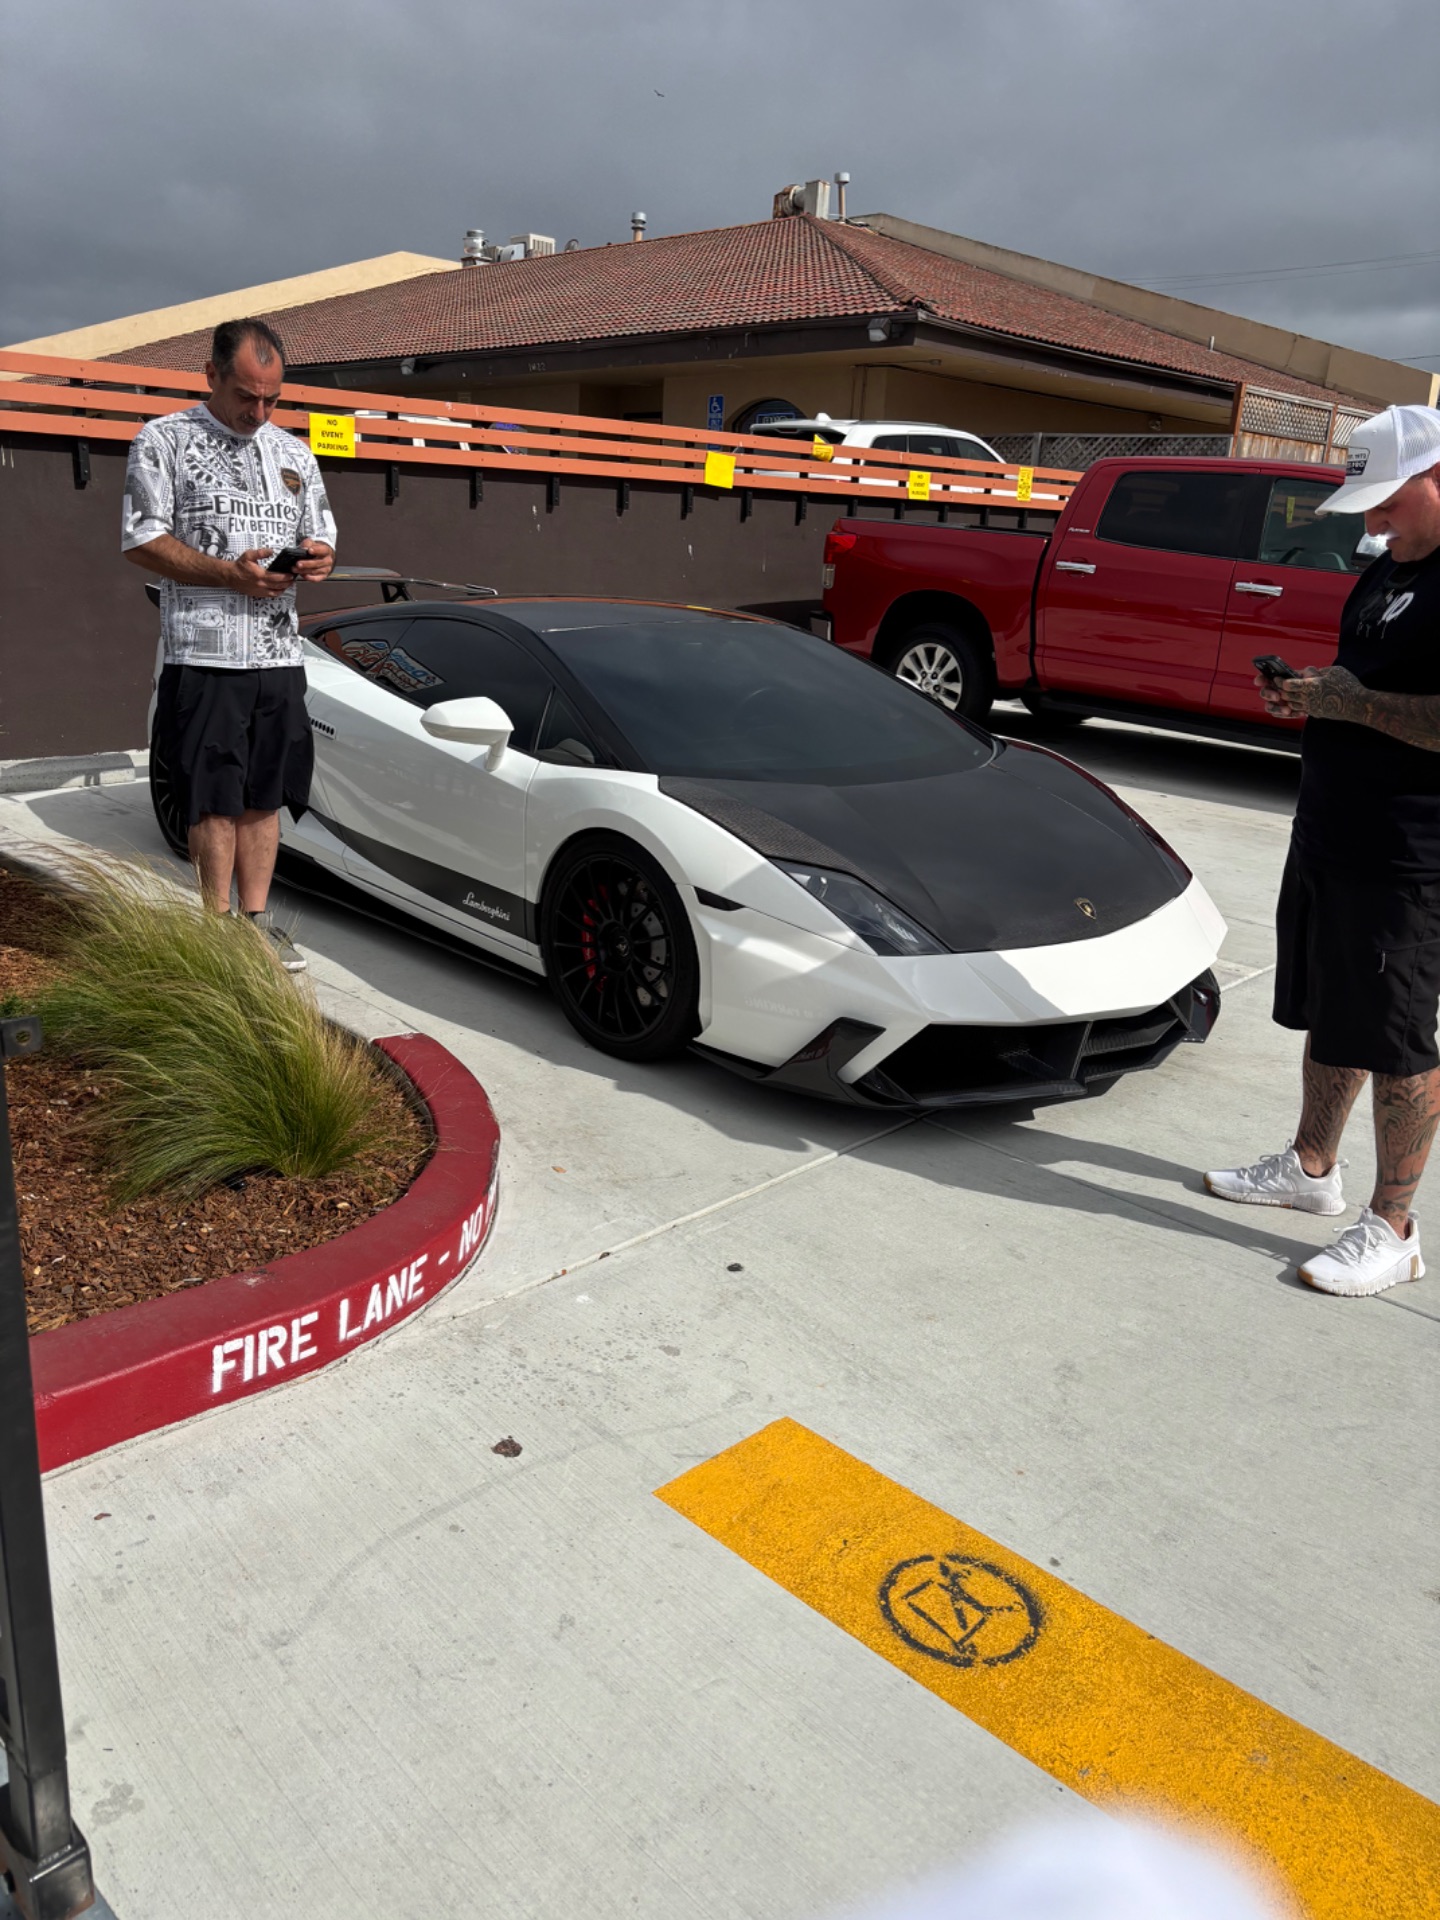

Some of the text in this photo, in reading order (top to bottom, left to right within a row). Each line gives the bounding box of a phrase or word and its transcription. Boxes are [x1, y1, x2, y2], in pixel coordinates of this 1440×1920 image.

[320, 430, 344, 439] EVENT
[316, 442, 349, 451] PARKING
[212, 494, 297, 522] Emirates
[228, 517, 246, 533] FLY
[462, 891, 511, 921] Lamborghini
[211, 1311, 319, 1394] FIRE
[338, 1253, 428, 1342] LANE
[458, 1203, 484, 1262] NO
